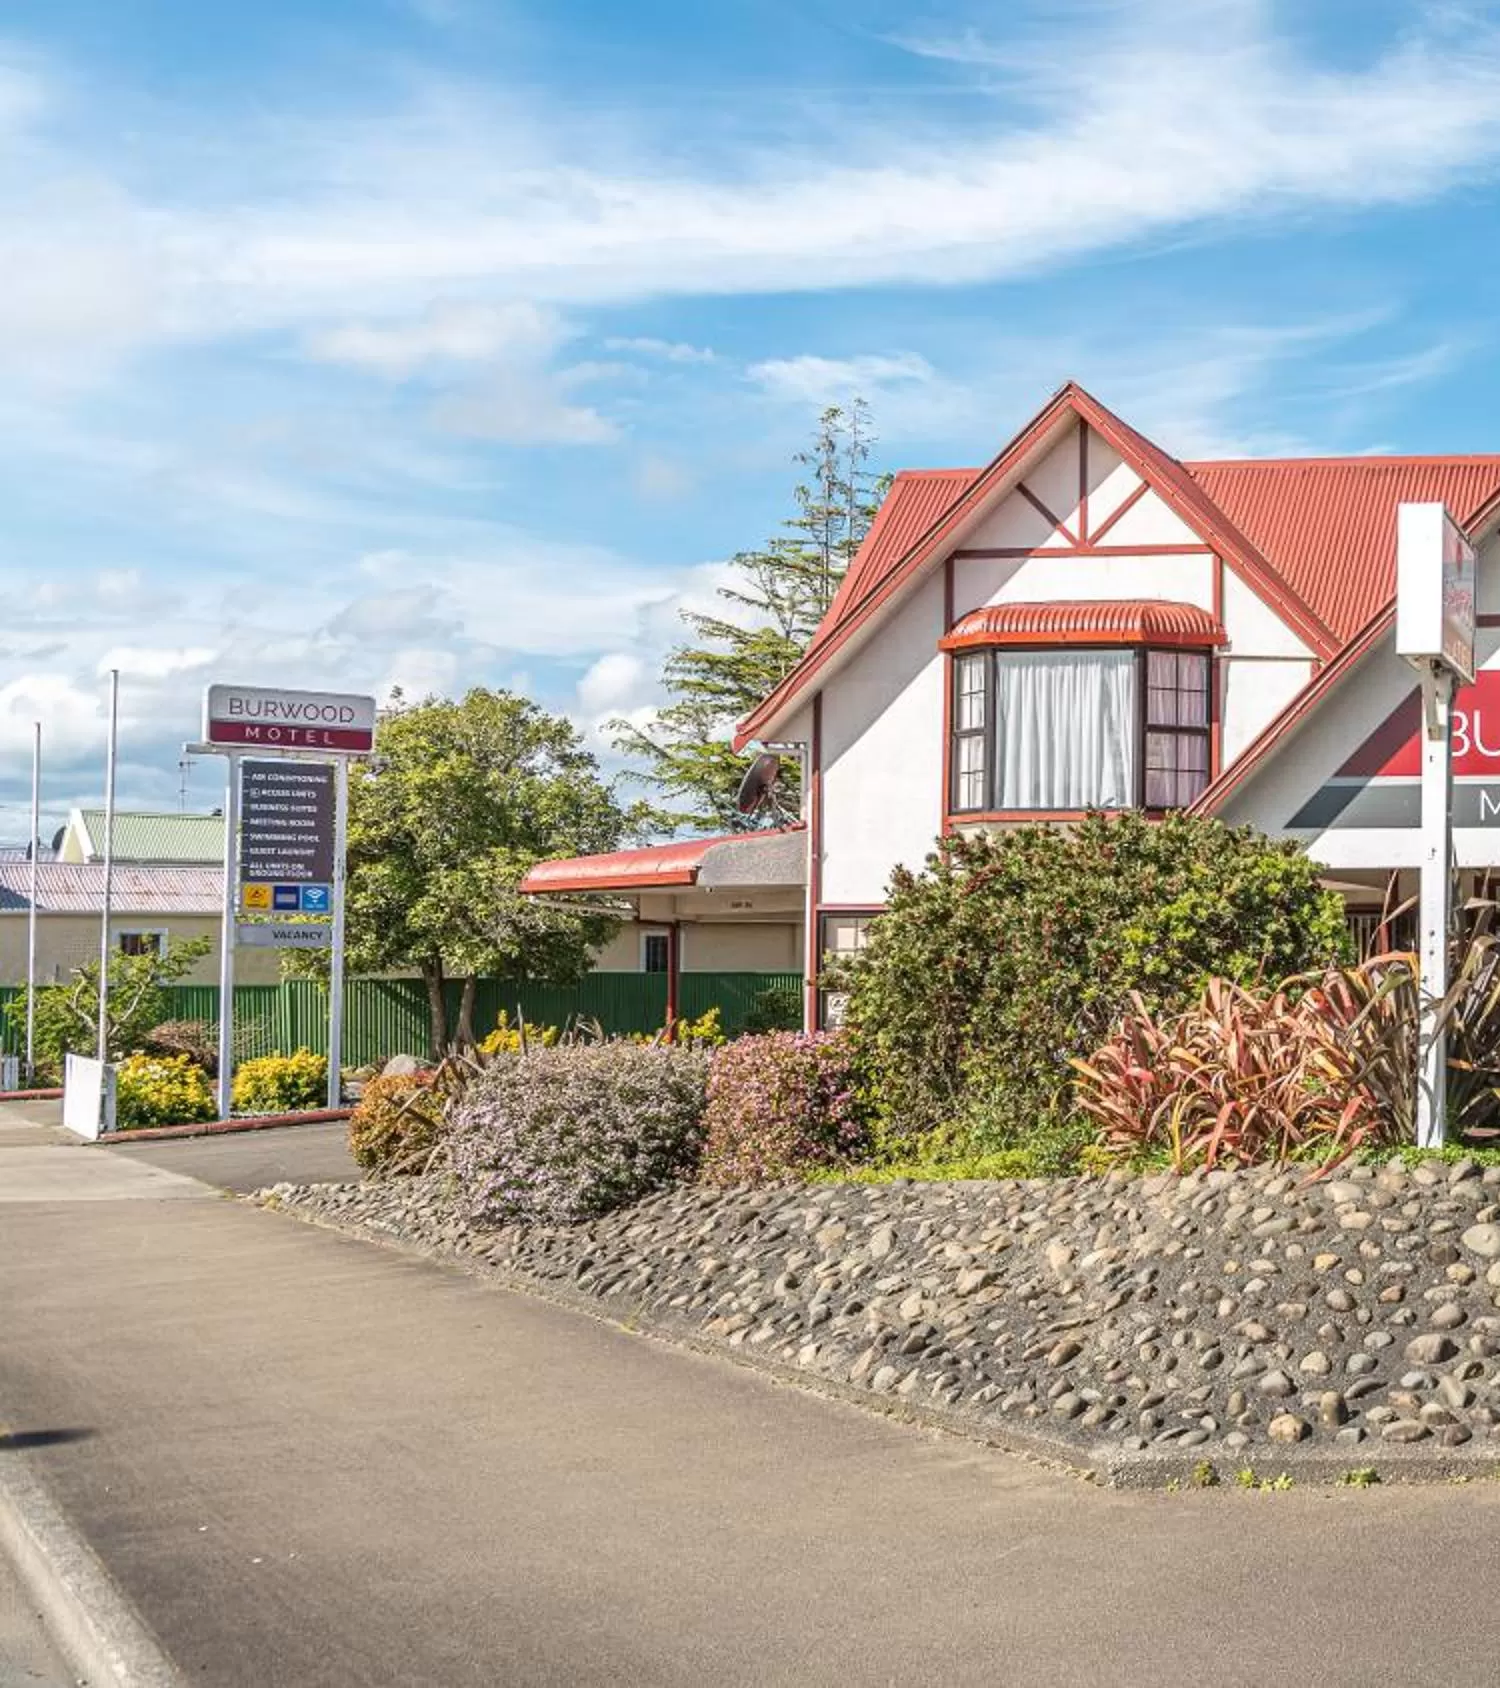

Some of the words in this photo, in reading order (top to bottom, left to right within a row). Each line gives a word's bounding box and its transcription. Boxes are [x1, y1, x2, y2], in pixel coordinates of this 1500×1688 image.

[229, 697, 355, 723] BURWOOD
[245, 727, 334, 745] MOTEL
[272, 930, 323, 941] VACANCY
